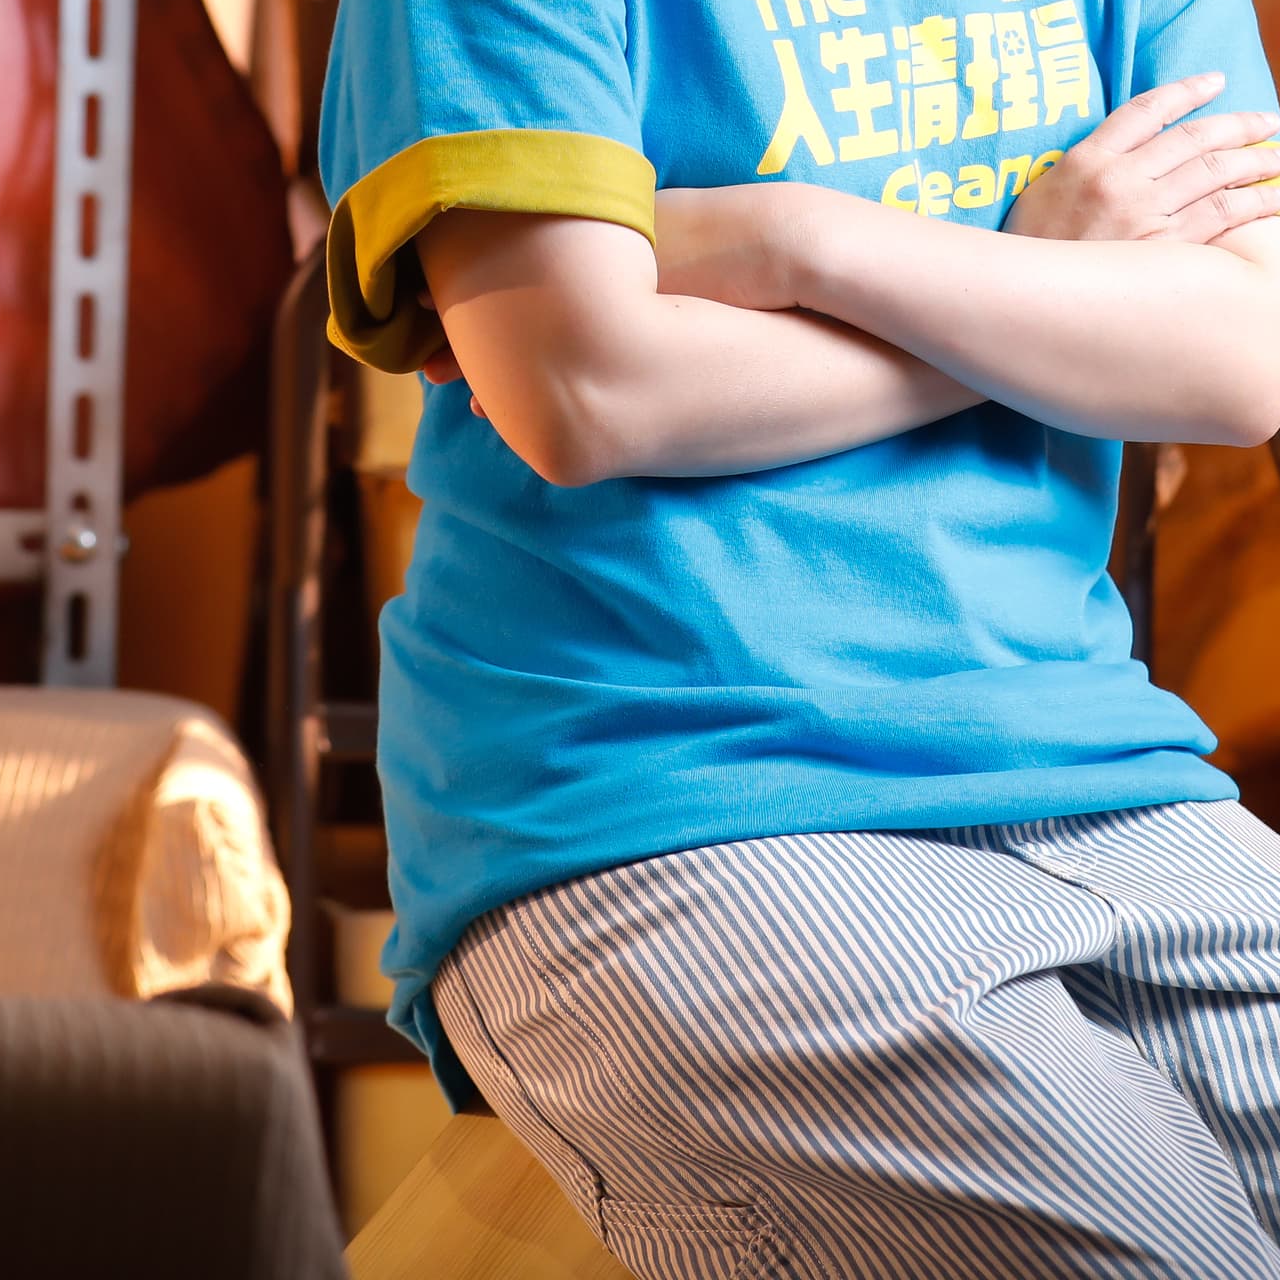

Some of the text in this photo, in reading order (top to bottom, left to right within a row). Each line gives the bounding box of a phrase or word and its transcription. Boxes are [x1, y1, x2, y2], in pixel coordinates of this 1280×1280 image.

[757, 0, 1090, 175] 人生清理員
